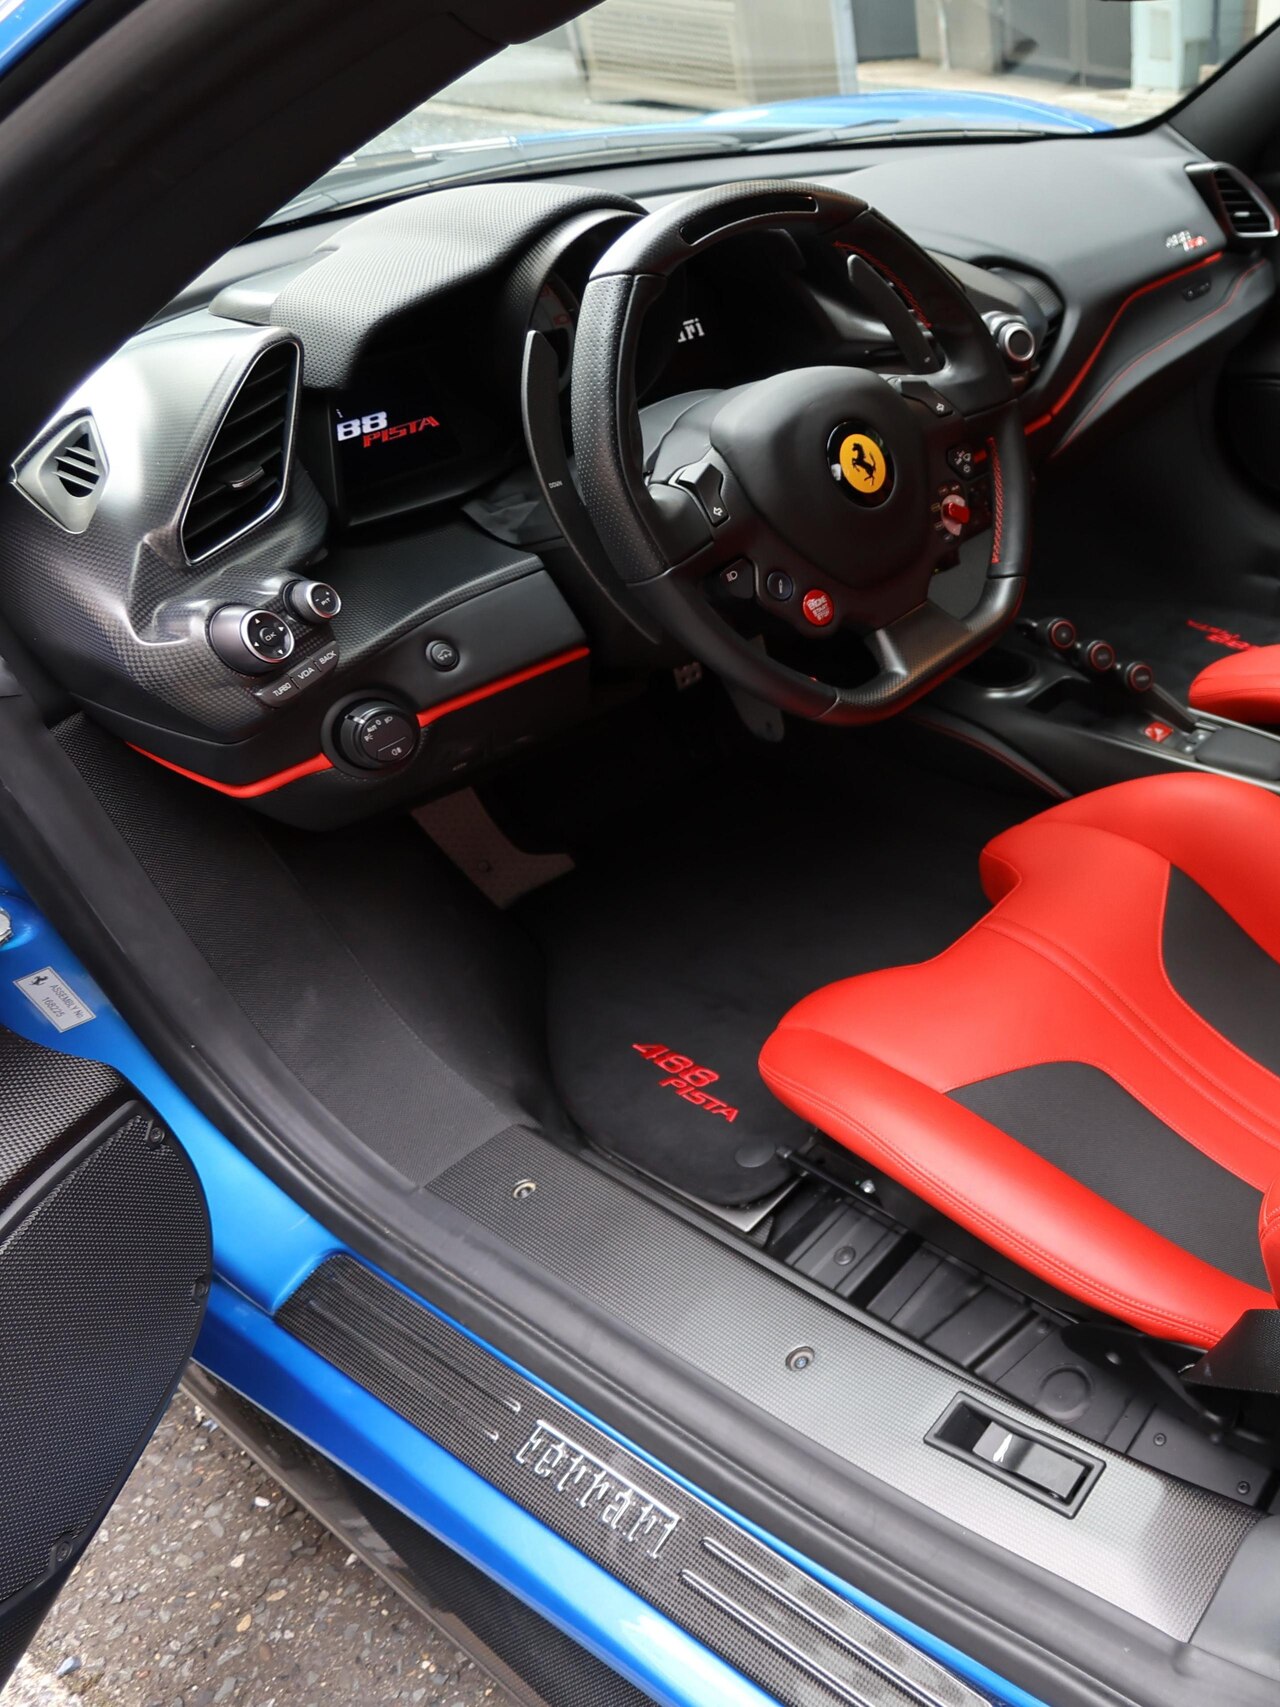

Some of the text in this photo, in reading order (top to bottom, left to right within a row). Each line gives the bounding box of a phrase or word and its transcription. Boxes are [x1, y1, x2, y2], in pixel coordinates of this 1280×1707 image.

[363, 416, 440, 448] PISTA
[265, 631, 276, 641] OK
[319, 650, 337, 664] BACK
[298, 667, 315, 680] VDA
[272, 682, 292, 697] TURBO
[42, 997, 66, 1018] 168225
[50, 984, 77, 1011] ASSEMBLY
[631, 1042, 720, 1088] 488
[657, 1076, 740, 1123] PISTA
[515, 1419, 682, 1559] Ferrari
